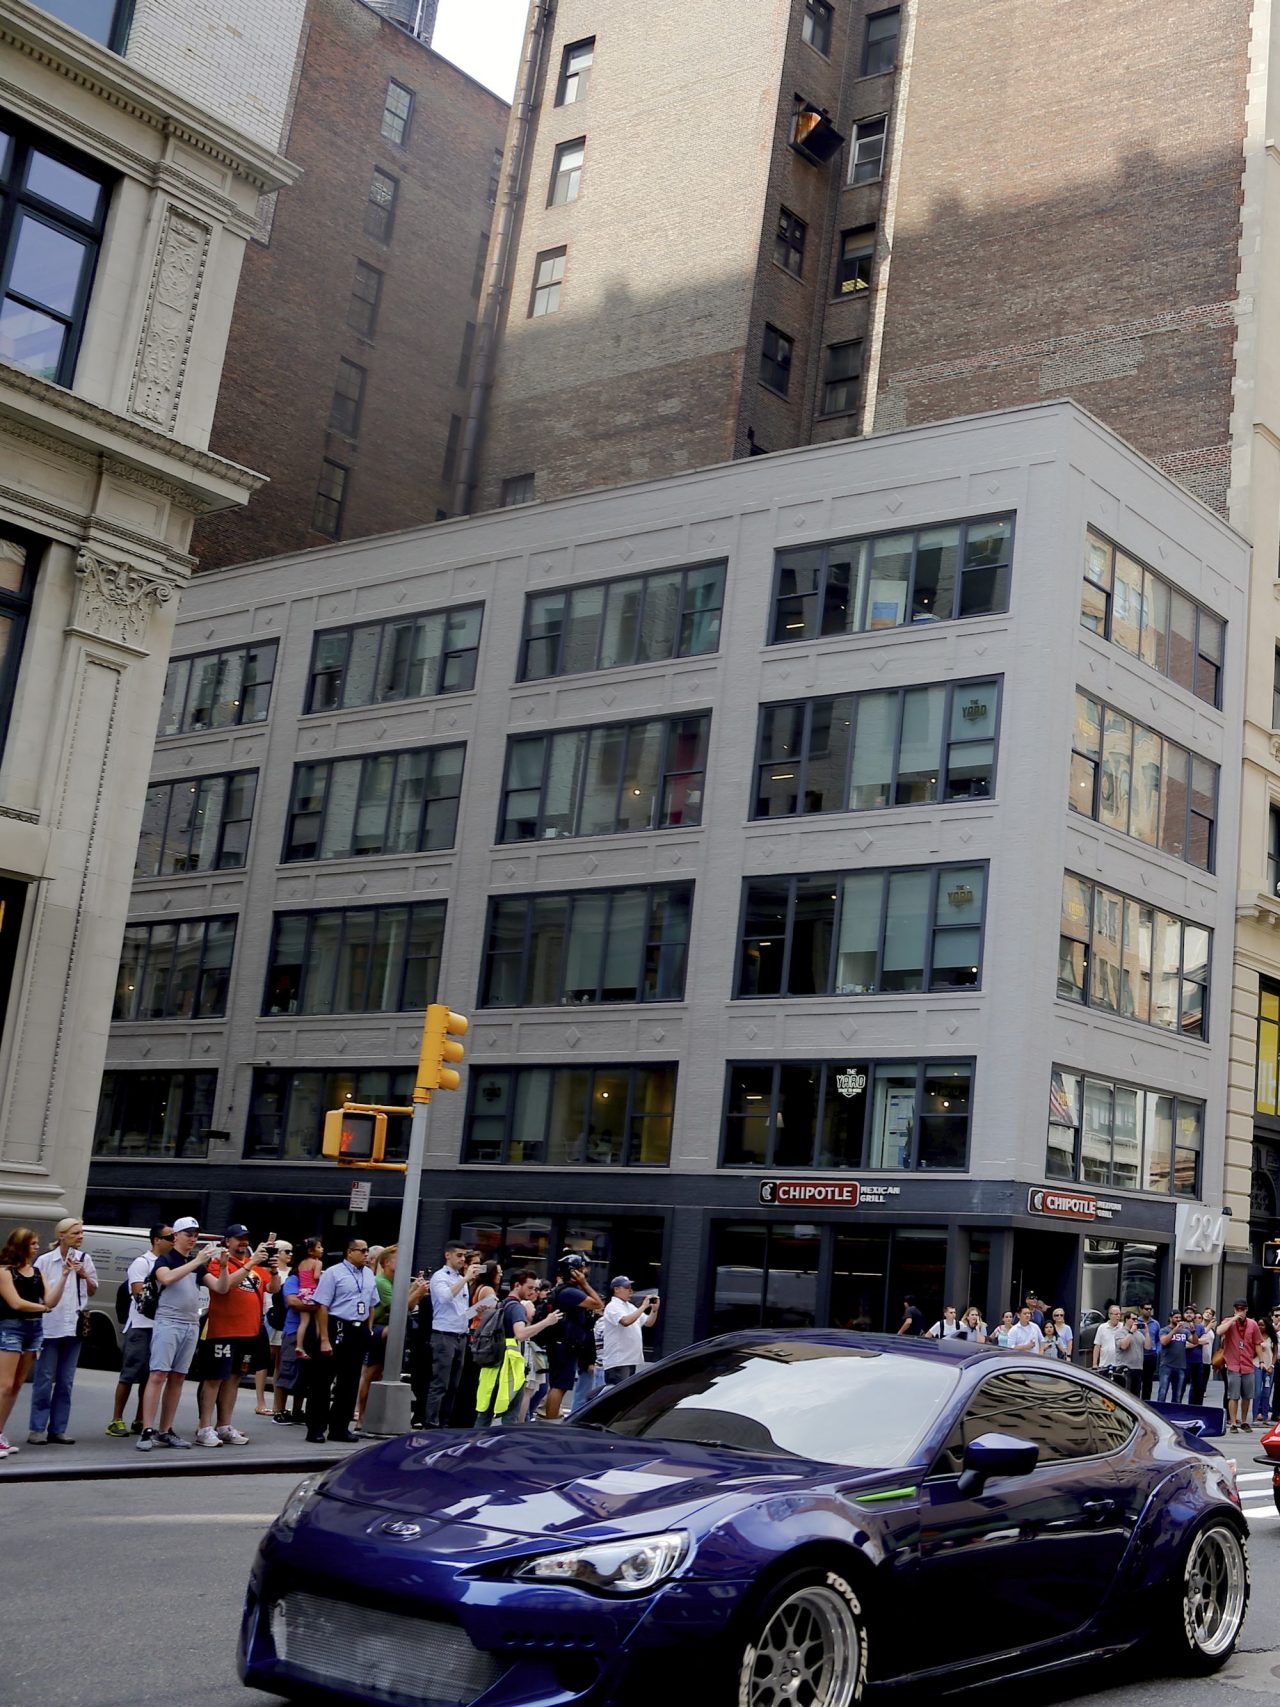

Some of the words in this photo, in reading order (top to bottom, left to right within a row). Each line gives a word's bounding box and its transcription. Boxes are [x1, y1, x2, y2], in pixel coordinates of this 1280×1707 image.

[836, 1075, 866, 1088] YARD
[779, 1186, 853, 1201] CHIPOTLE
[860, 1186, 901, 1195] MEXICAN
[860, 1194, 886, 1203] GRILL
[1046, 1195, 1097, 1215] CHIPOTLE
[1185, 1213, 1224, 1253] 234
[214, 1344, 232, 1358] 54
[826, 1571, 862, 1616] TOYO
